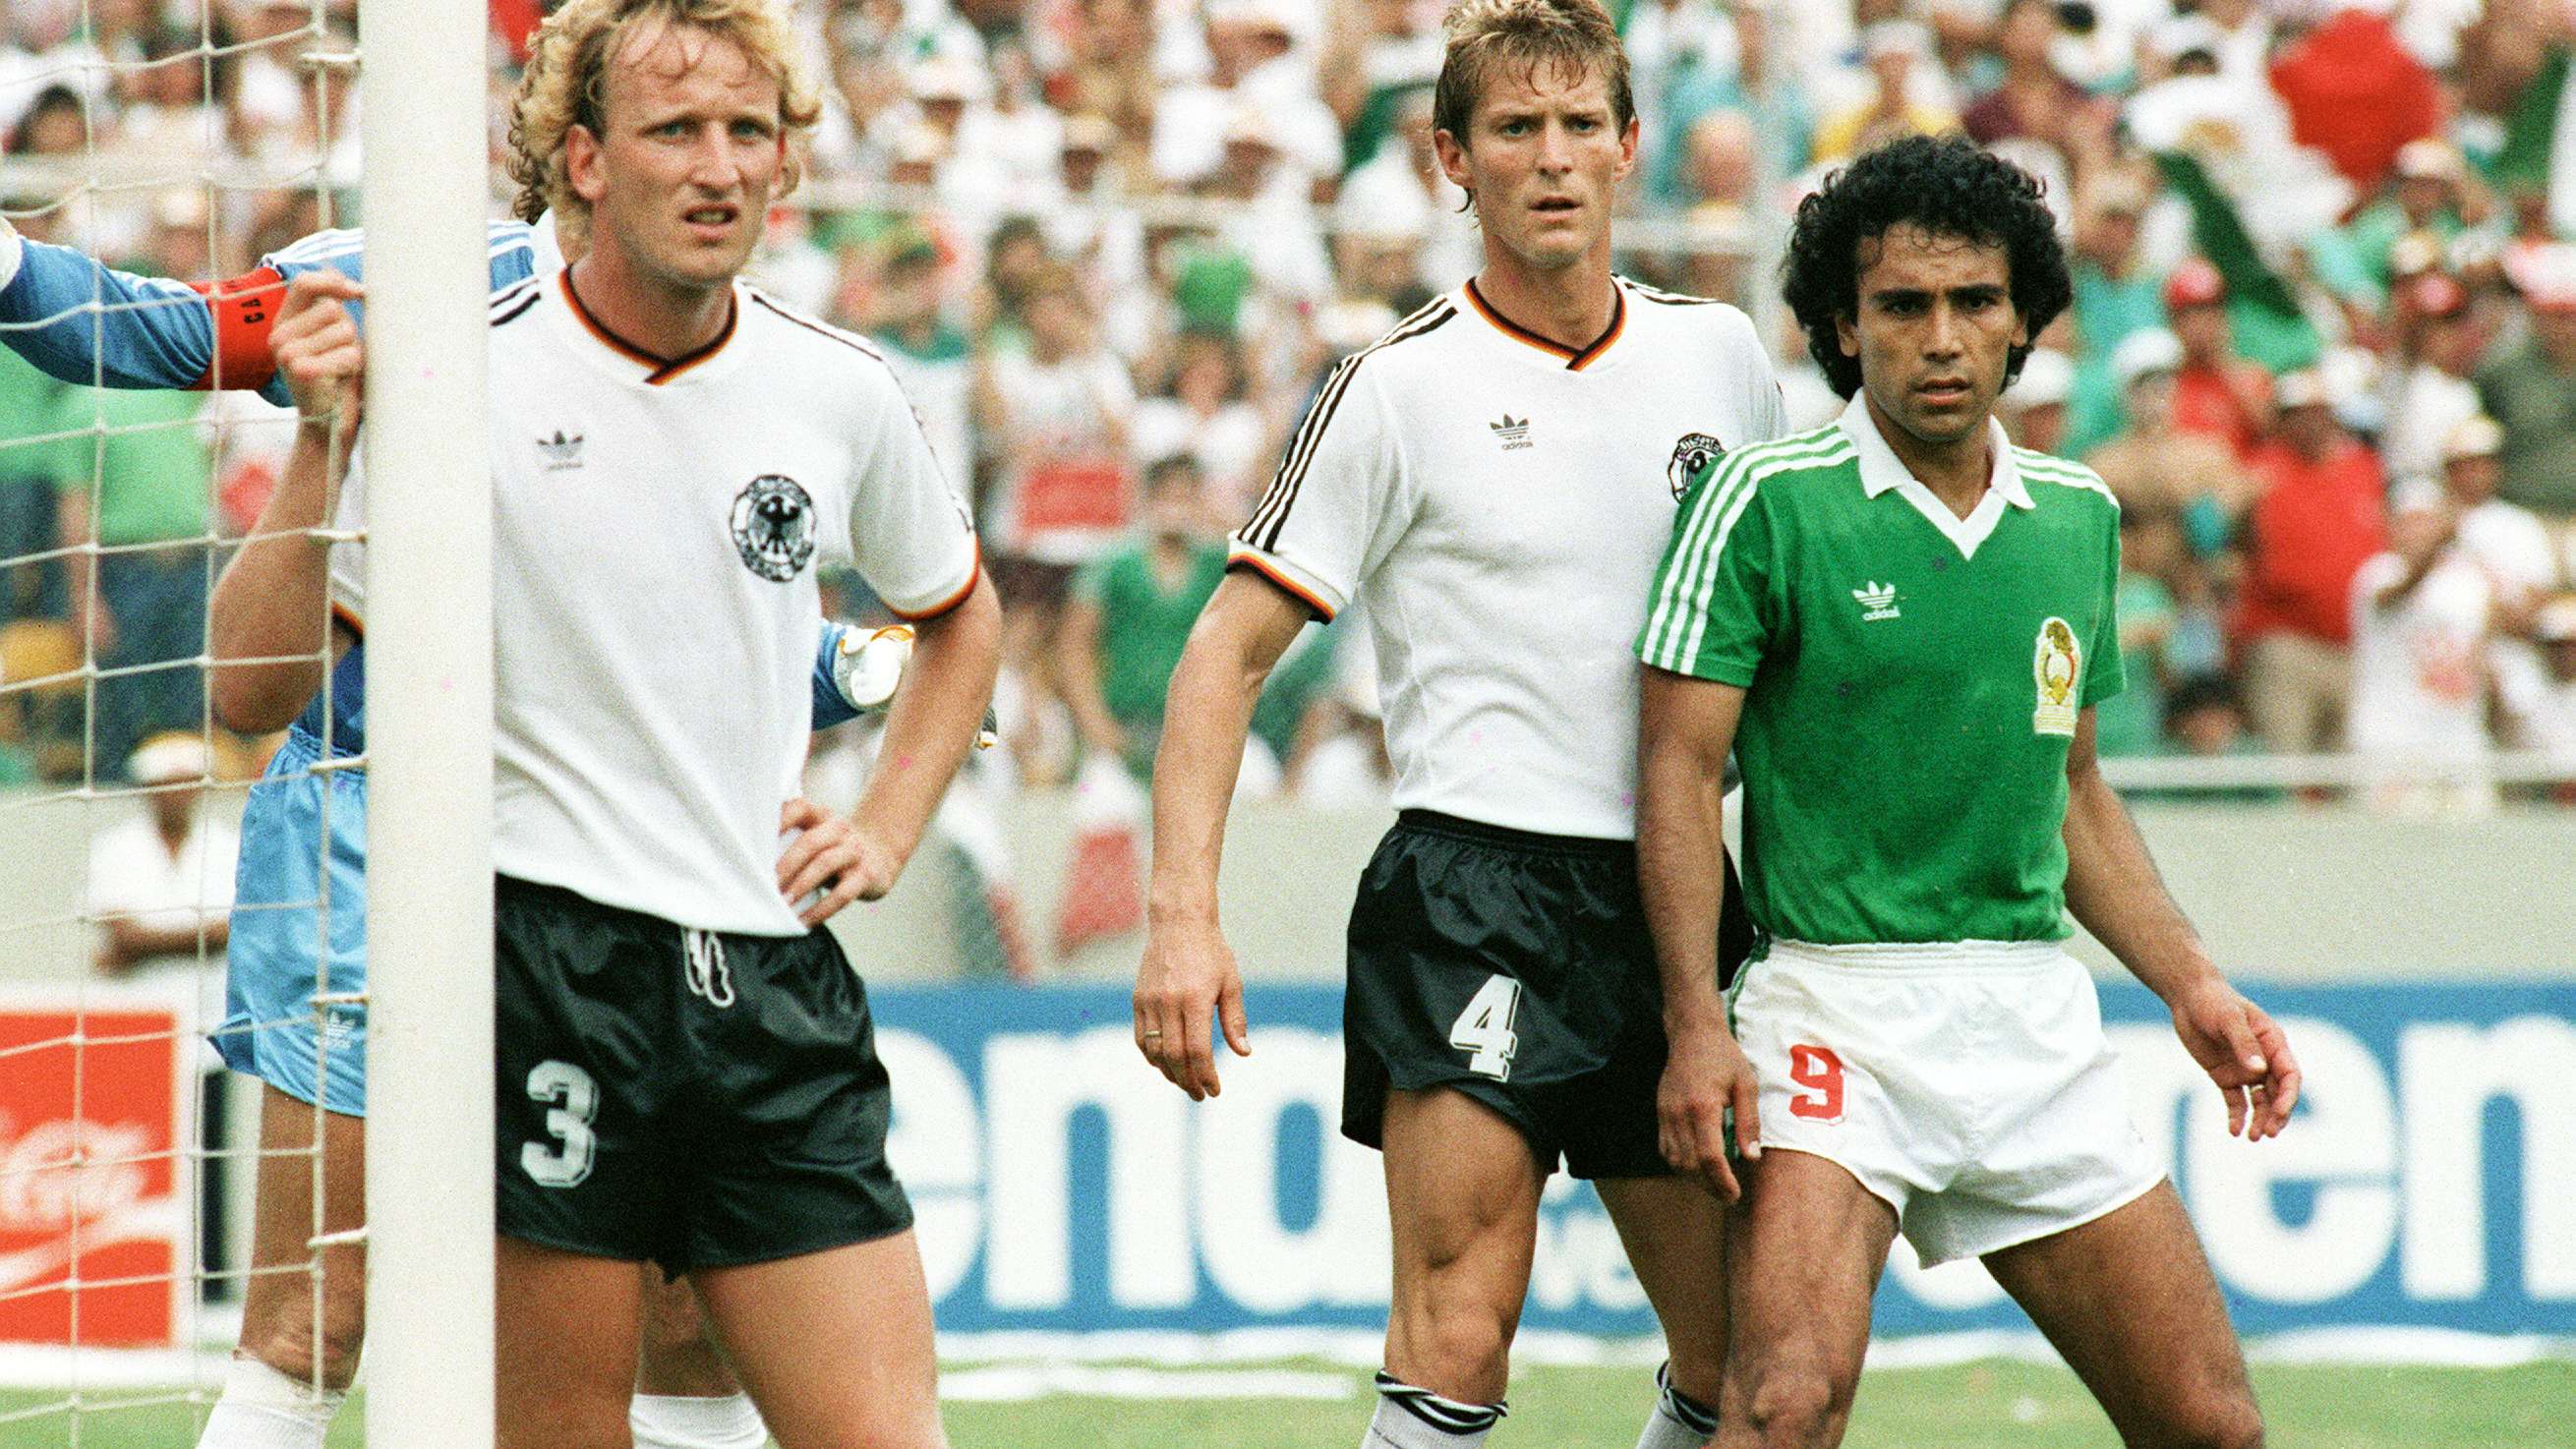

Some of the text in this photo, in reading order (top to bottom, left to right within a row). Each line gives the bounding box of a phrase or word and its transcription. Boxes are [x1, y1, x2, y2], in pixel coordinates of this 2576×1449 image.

[1501, 440, 1534, 451] adidas
[1862, 606, 1901, 621] adidas
[1449, 972, 1522, 1083] 4
[520, 1059, 600, 1188] 3
[1788, 1043, 1847, 1127] 9
